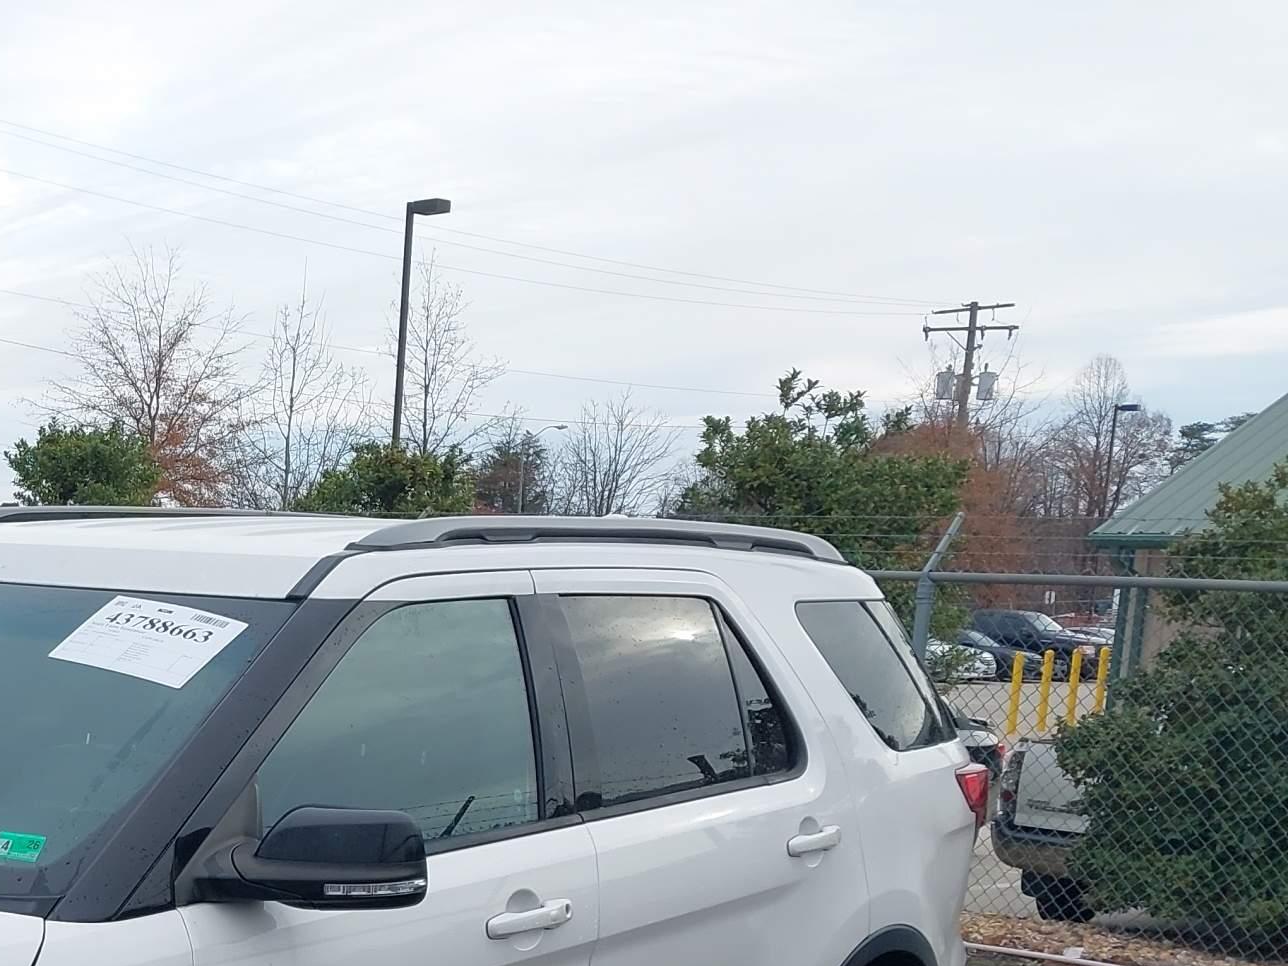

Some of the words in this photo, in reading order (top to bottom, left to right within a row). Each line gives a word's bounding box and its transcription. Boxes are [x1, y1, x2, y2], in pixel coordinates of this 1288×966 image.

[105, 612, 214, 643] 43788663
[1, 840, 11, 851] 4
[26, 840, 41, 850] 26
